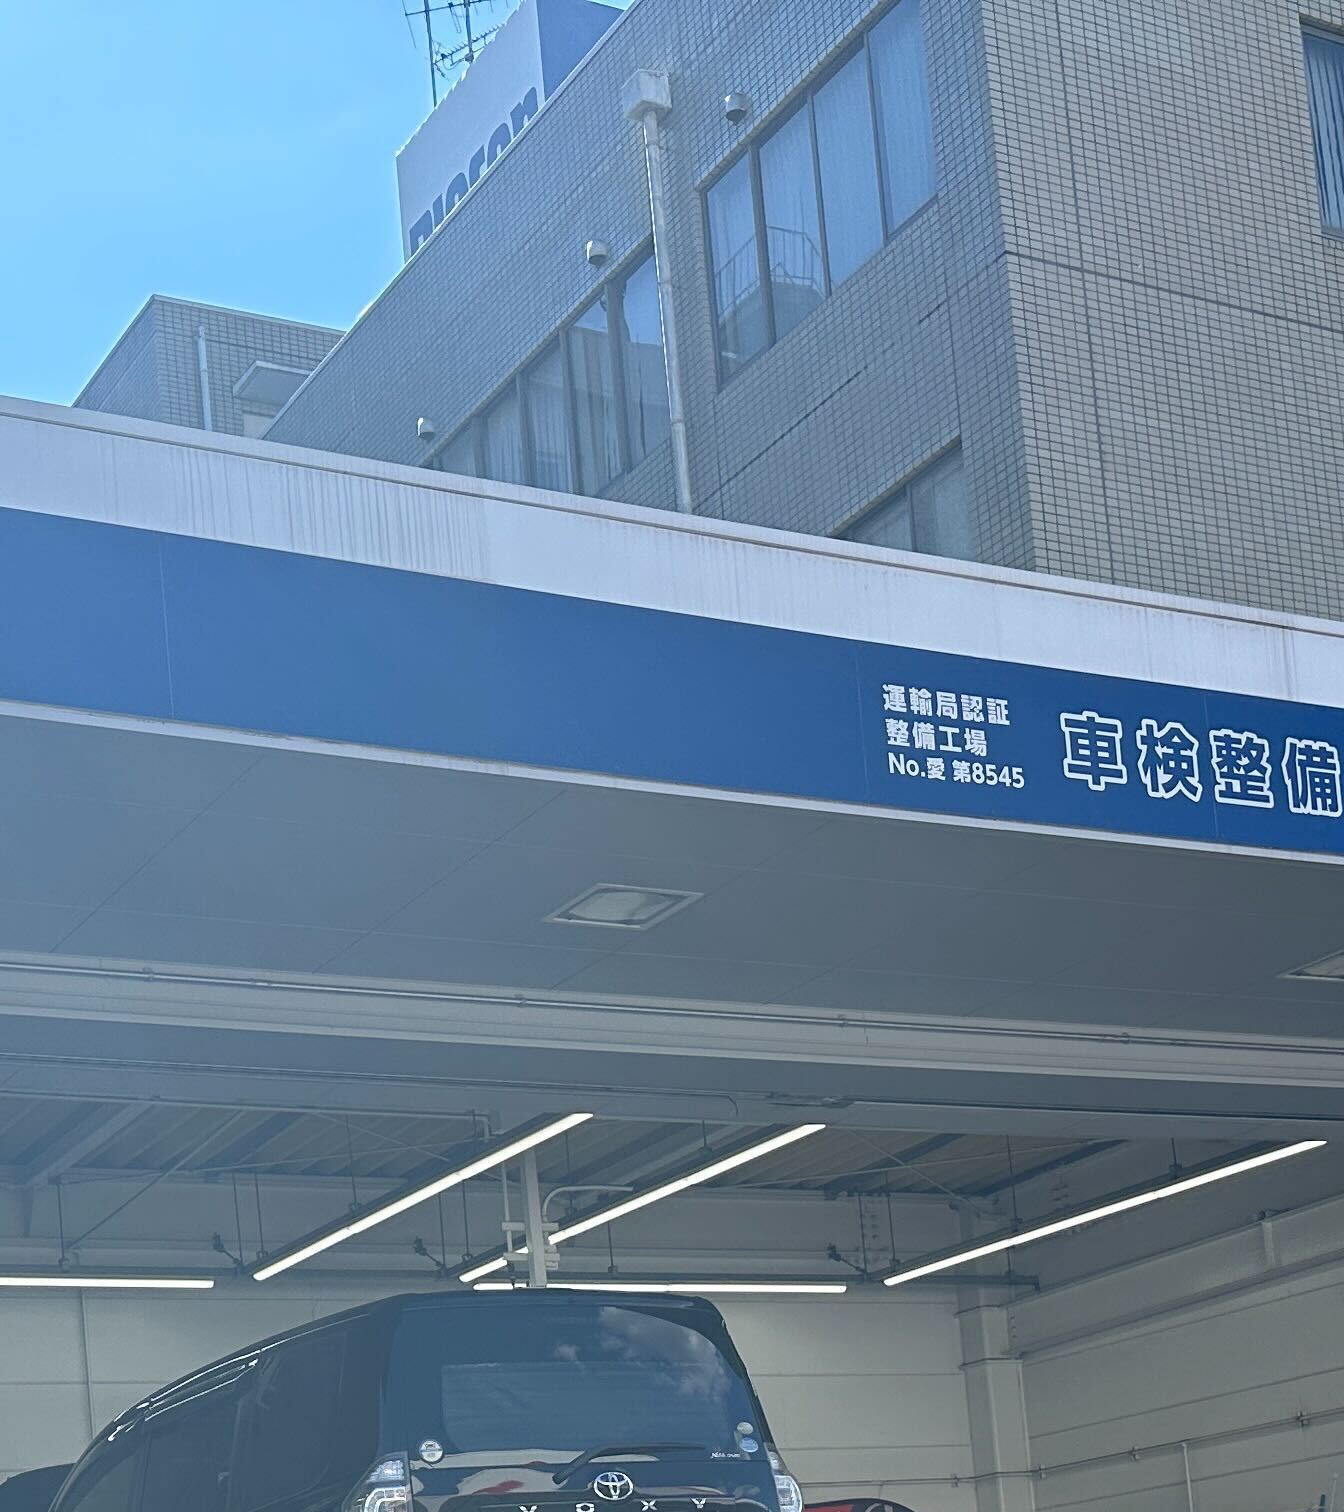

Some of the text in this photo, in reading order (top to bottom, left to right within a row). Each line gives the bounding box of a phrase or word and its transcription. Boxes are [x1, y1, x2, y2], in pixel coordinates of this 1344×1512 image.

[882, 683, 1011, 727] 運輸局認証
[884, 718, 988, 758] 整備工場
